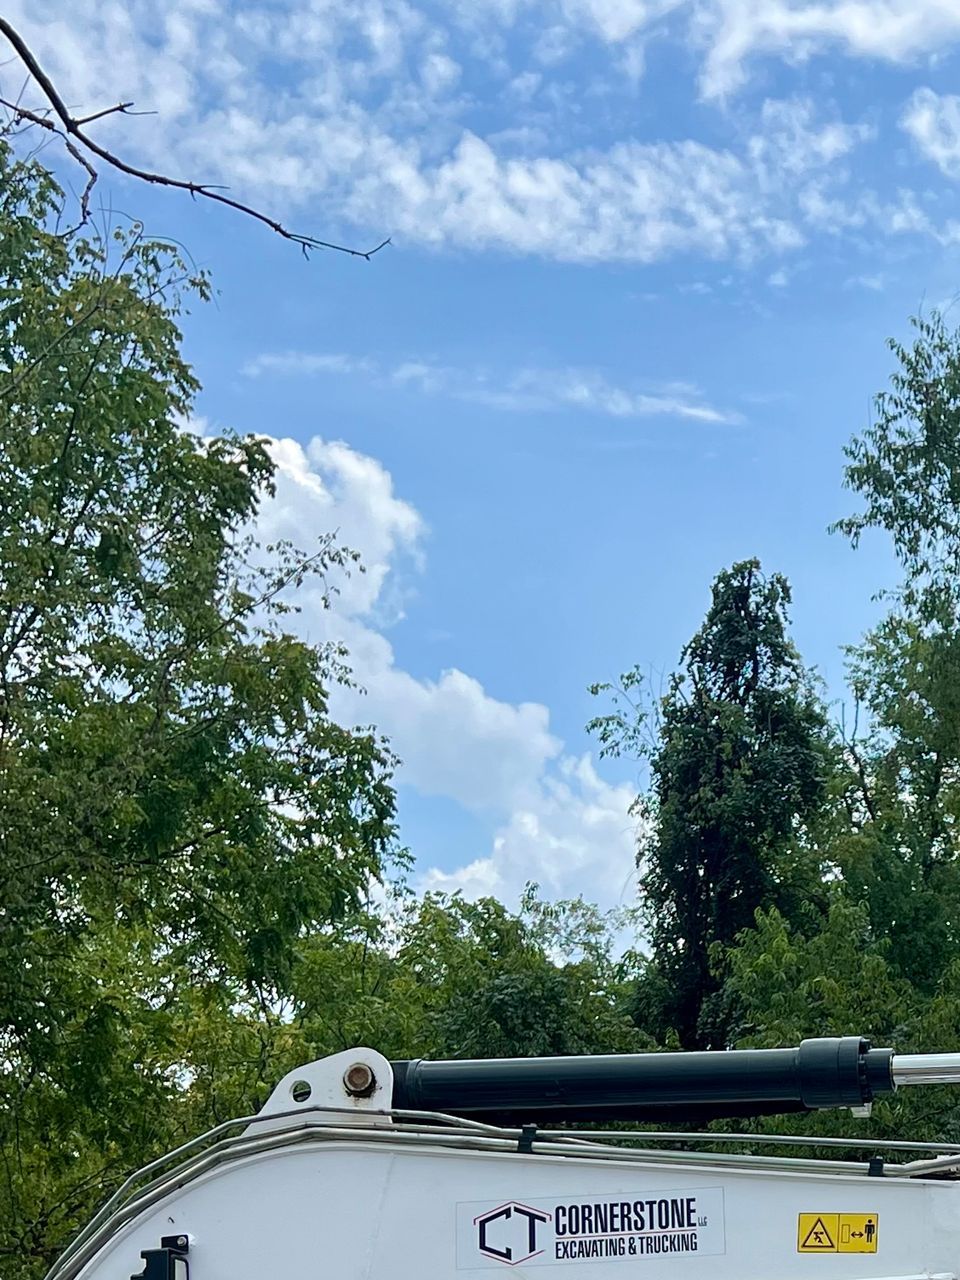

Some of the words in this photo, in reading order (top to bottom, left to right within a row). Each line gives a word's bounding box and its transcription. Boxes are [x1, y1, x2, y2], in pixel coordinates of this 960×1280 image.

[555, 1197, 697, 1236] CORNERSTONE
[555, 1237, 626, 1259] EXCAVATING
[628, 1237, 637, 1256] &
[638, 1232, 698, 1255] TRUCKING
